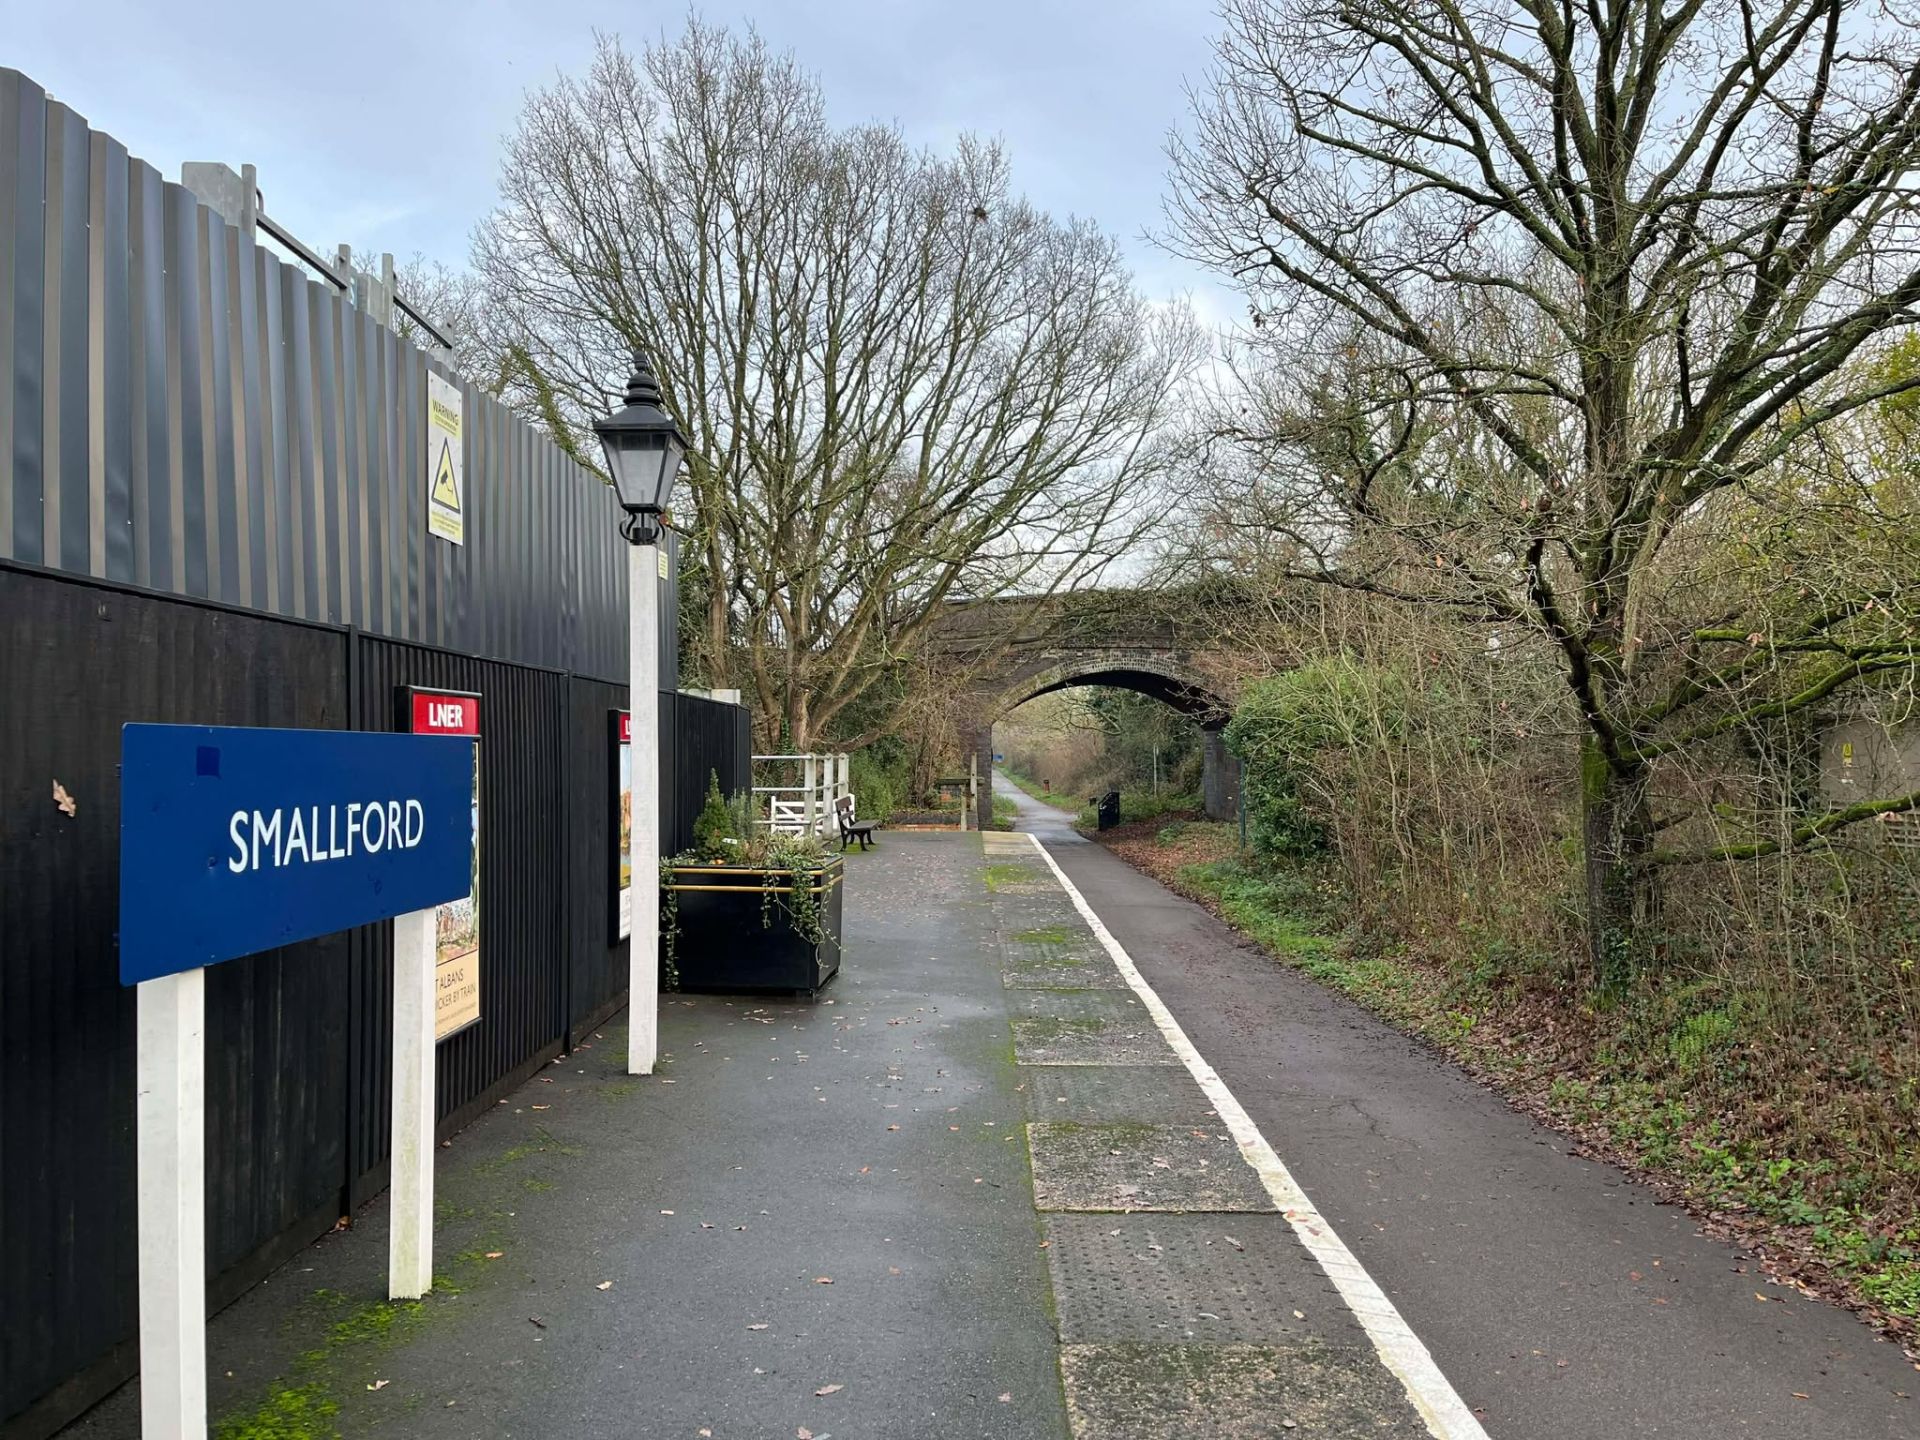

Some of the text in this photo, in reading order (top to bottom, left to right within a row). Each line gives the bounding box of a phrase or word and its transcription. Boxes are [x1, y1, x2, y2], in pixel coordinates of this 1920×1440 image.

[432, 398, 458, 426] WARNING
[428, 702, 464, 728] LNER
[228, 799, 424, 873] SMALLFORD
[440, 968, 464, 991] ALBANS
[460, 983, 476, 1000] TRAIN
